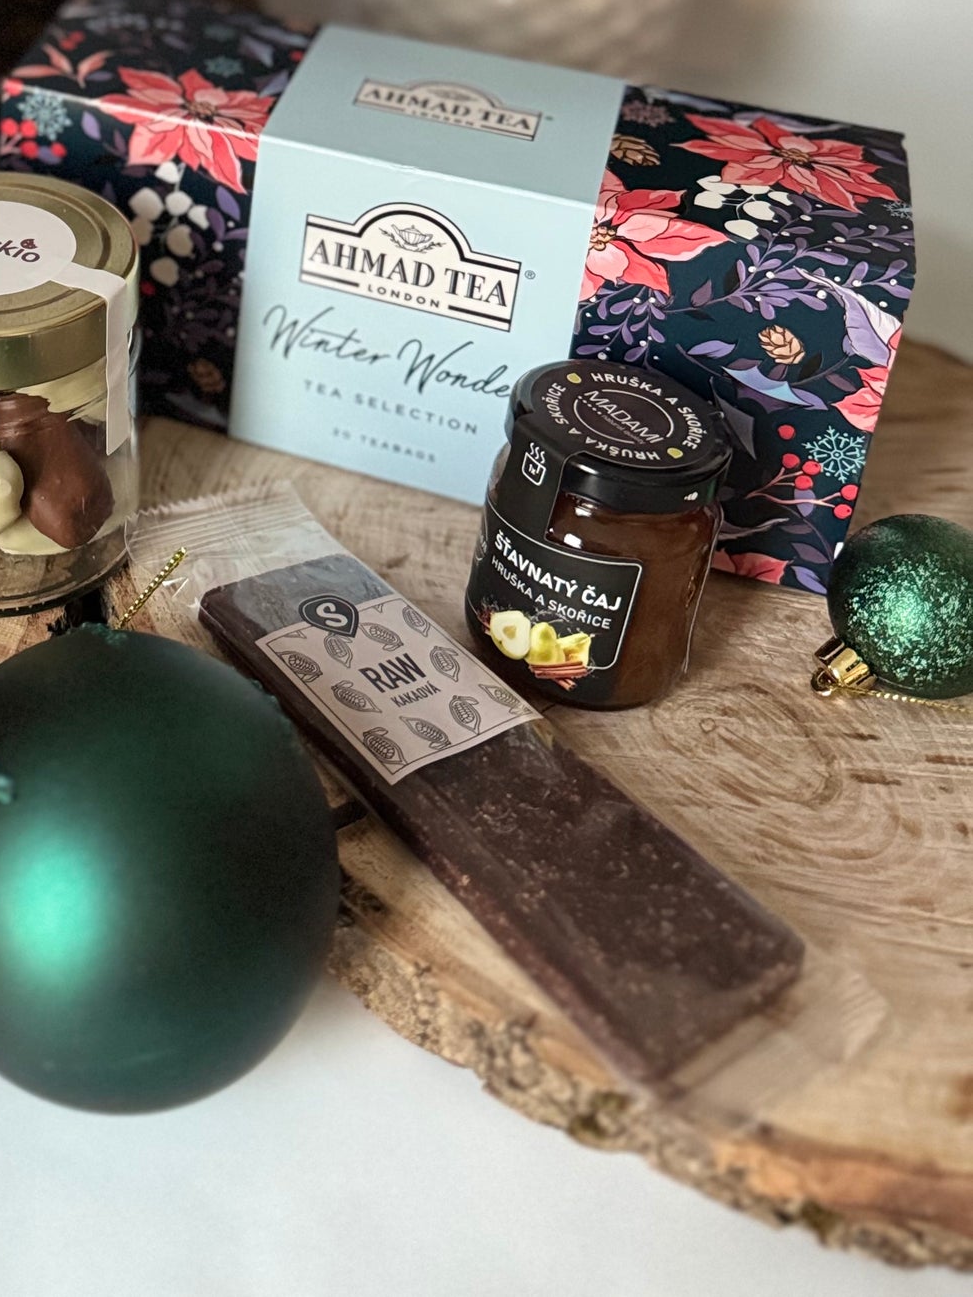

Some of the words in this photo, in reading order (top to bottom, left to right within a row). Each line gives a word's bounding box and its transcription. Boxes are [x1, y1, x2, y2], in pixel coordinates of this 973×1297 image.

[364, 88, 471, 118] AHMAD
[479, 108, 531, 130] TEA
[308, 238, 436, 289] AHMAD
[444, 267, 508, 308] TEA
[367, 283, 441, 309] LONDON
[262, 304, 393, 366] Winter
[304, 379, 342, 399] TEA
[355, 392, 478, 435] SELECTION
[541, 382, 569, 425] SKOŘICE
[584, 390, 664, 444] MADAMI
[590, 372, 662, 397] HRUŠKA
[665, 397, 678, 406] A
[677, 406, 708, 450] SKOŘICE
[360, 434, 436, 463] TEABAGS
[568, 427, 582, 435] A
[585, 436, 661, 461] HRUŠKA
[494, 529, 578, 599] ŠŤAVNATÝ
[581, 584, 622, 612] ČAJ
[491, 555, 534, 600] HRUŠKA
[535, 594, 545, 606] A
[548, 599, 612, 630] SKOŘICE
[358, 653, 427, 693] RAW
[391, 681, 442, 708] KAKAOVÁ
